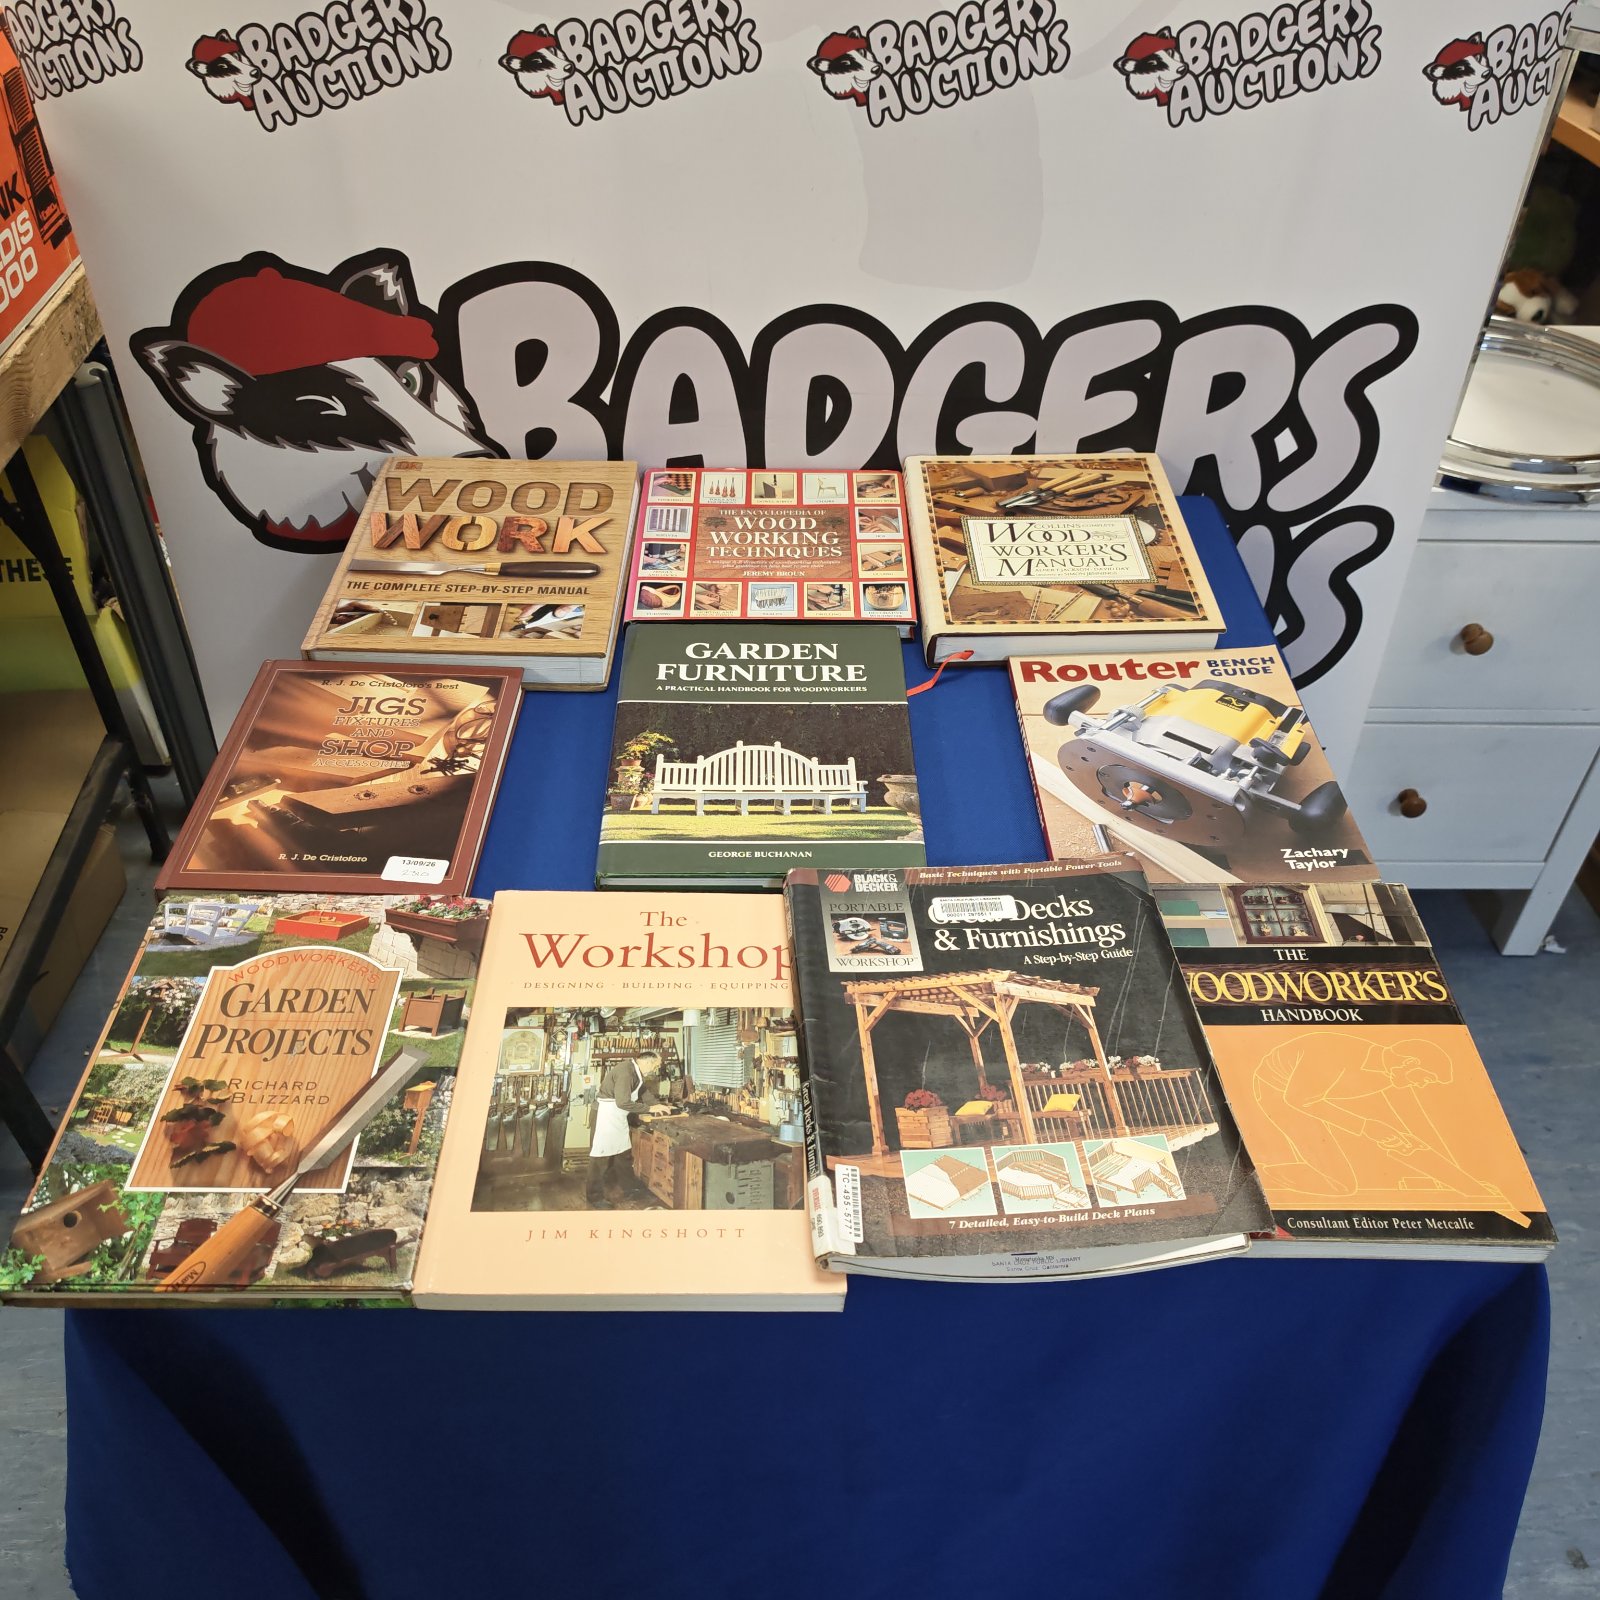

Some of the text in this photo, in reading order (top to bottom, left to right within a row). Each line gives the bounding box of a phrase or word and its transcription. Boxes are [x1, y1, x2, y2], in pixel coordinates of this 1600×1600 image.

[253, 16, 452, 132] AUCTIONS
[564, 18, 762, 127] AUCTIONS
[867, 19, 1070, 128] AUCTIONS
[1168, 25, 1382, 128] AUCTIONS
[437, 261, 1420, 514] BADGERS
[385, 477, 614, 515] WOOD
[370, 512, 615, 553] WORK
[734, 517, 817, 530] WOOD
[985, 522, 1091, 543] WOOD
[710, 531, 840, 545] WORKING
[706, 546, 842, 558] TECHNIQUES
[990, 544, 1127, 562] WORKER'S
[997, 557, 1113, 577] MANUAL
[346, 580, 590, 595] THE COMPLETE STEP-BY-STEP MANUAL
[685, 642, 839, 660] GARDEN
[656, 663, 868, 681] FURNITURE
[1020, 656, 1276, 683] Router BENCH
[1209, 664, 1274, 677] GUIDE
[436, 682, 460, 690] Best
[338, 696, 428, 716] JIGS
[332, 716, 423, 727] FIXTURES
[350, 728, 395, 738] AND
[318, 739, 416, 758] SHOP
[312, 758, 412, 769] ACCESSORIES
[278, 853, 288, 861] R.
[1280, 848, 1349, 858] Zachary
[1023, 866, 1063, 874] Portable
[1097, 860, 1122, 868] Tools
[1285, 859, 1337, 871] Taylor
[855, 882, 898, 893] DECKER
[830, 902, 904, 911] PORTABLE
[1010, 894, 1094, 921] Decks
[640, 911, 688, 927] The
[934, 921, 1126, 951] & Furnishings
[518, 931, 790, 980] Workshop
[1023, 947, 1133, 966] A Step-by-Step Guide
[1274, 949, 1309, 961] THE
[523, 982, 790, 990] DESIGNING BUILDING EQUIPPING
[220, 983, 376, 1018] GARDEN
[1260, 1008, 1363, 1022] HANDBOOK
[188, 1024, 374, 1062] PROJECTS
[227, 1078, 317, 1090] RICHARD
[231, 1092, 329, 1104] BLIZZARD
[804, 1106, 815, 1134] Decks
[807, 1143, 820, 1181] Furnish
[949, 1207, 1156, 1229] 7 Detailed, Easy-to-Build Deck Plans
[1287, 1217, 1475, 1230] Consultant Editor Peter Metcalfe
[525, 1229, 745, 1242] JIM KINGSHOTT
